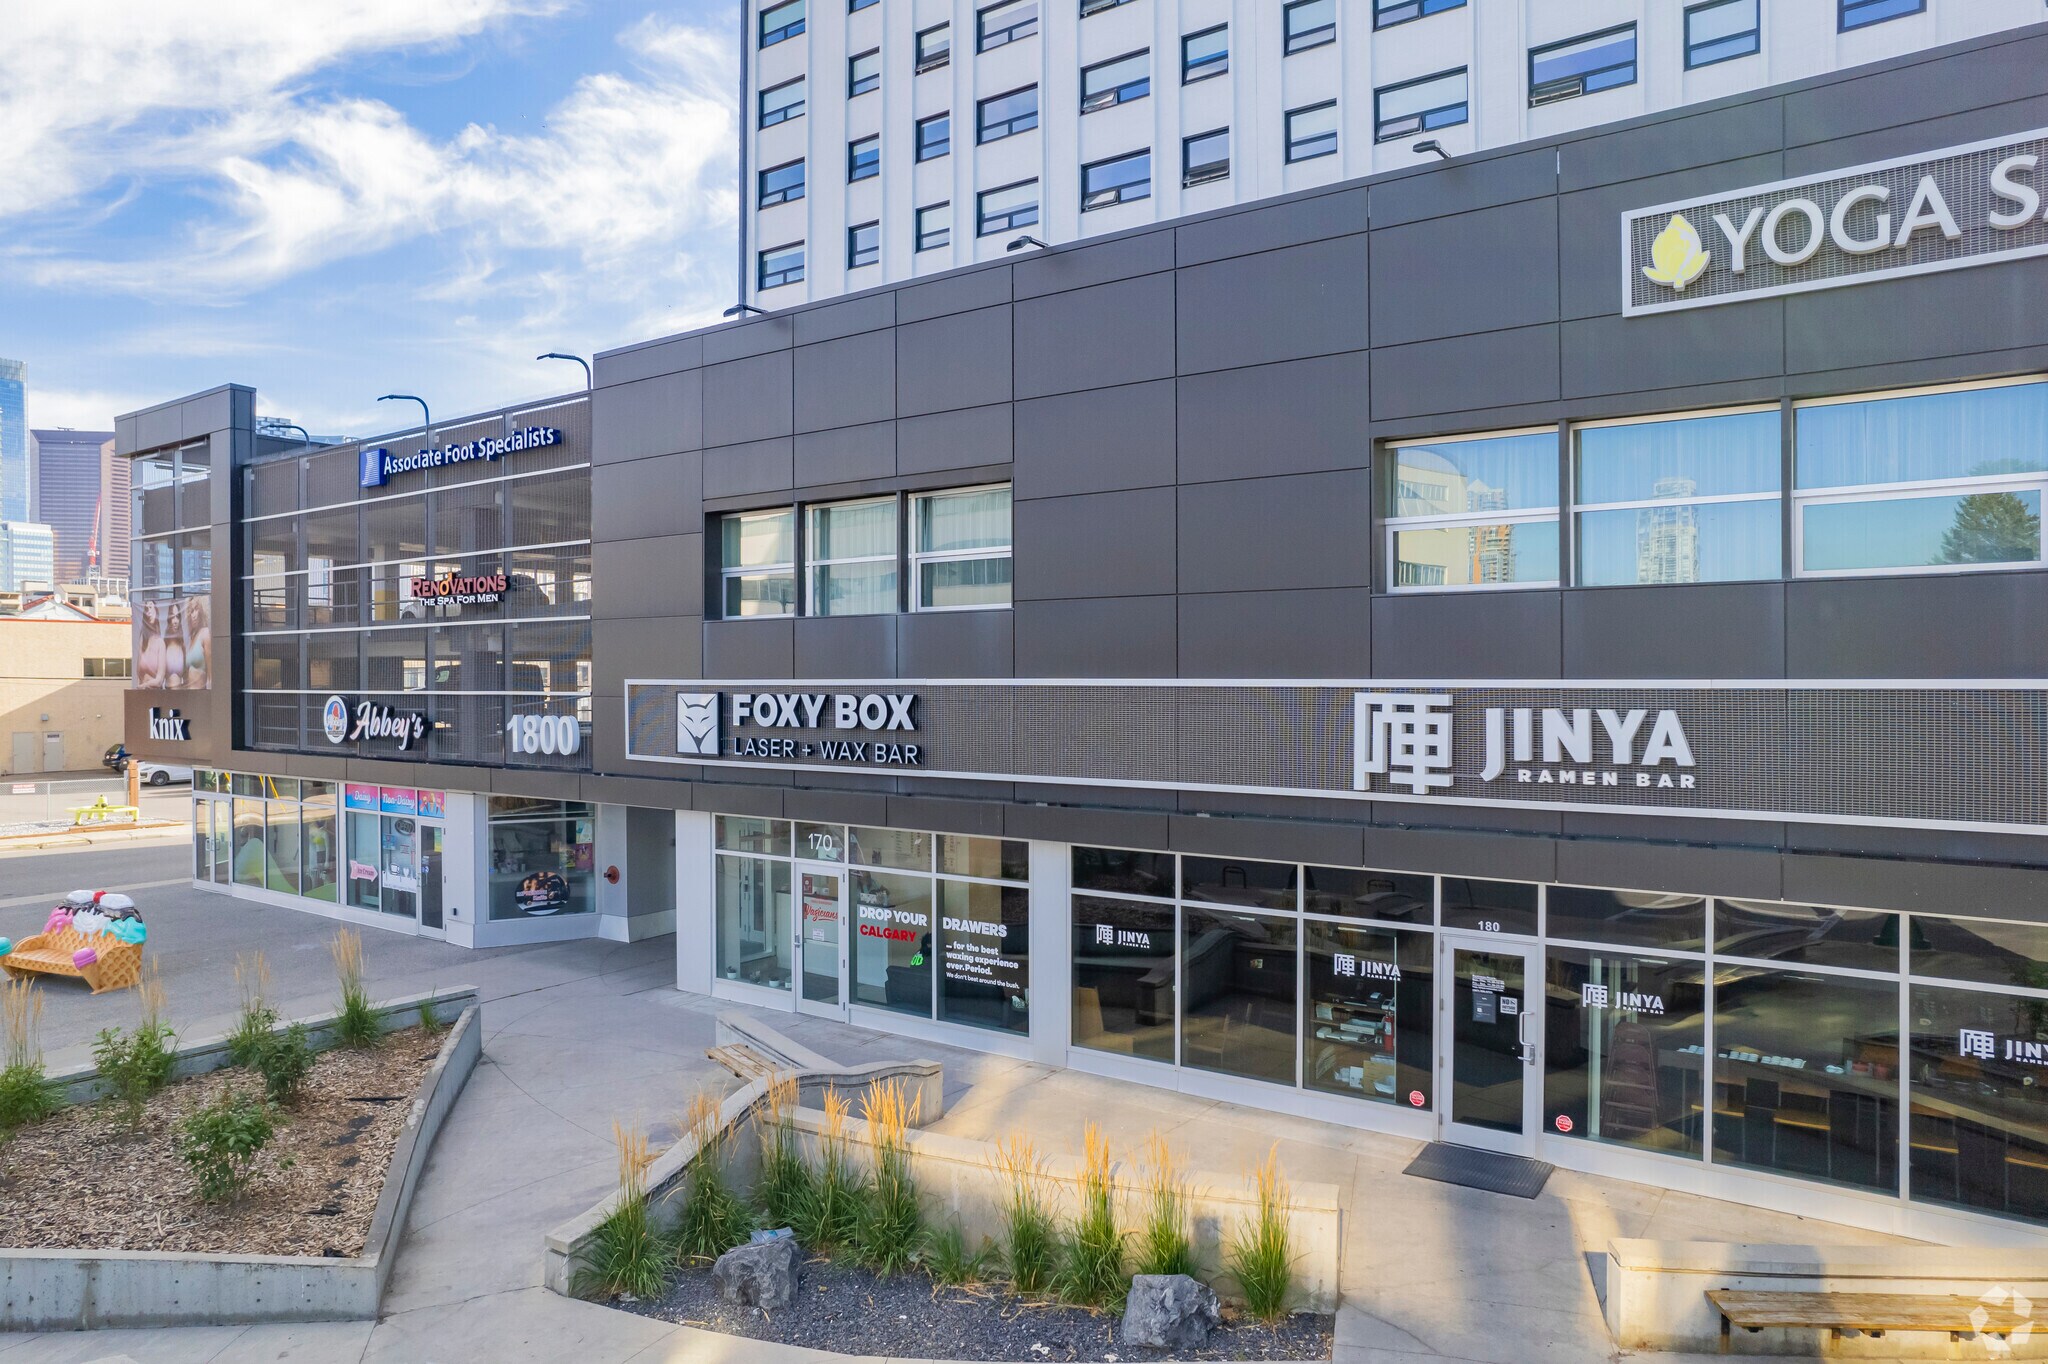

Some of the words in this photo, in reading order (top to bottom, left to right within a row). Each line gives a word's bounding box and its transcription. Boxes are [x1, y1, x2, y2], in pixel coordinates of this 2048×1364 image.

[1713, 175, 1961, 274] YOGA
[1989, 154, 2048, 230] S
[384, 449, 441, 474] Associate
[445, 442, 475, 464] Foot
[478, 427, 554, 461] Specialists
[411, 572, 507, 598] RENOVATIONS
[419, 598, 435, 606] THE
[437, 596, 455, 605] SPA
[457, 595, 475, 604] FOR
[477, 593, 499, 603] MEN
[733, 693, 826, 728] FOXY
[835, 693, 917, 731] BOX
[149, 707, 185, 741] knix
[349, 701, 424, 751] Abbey's
[507, 714, 577, 756] 1800
[1480, 708, 1697, 782] JINYA
[734, 737, 795, 758] LASER
[820, 740, 867, 762] WAX
[875, 743, 919, 765] BAR
[1518, 769, 1618, 786] RAMEN
[1636, 772, 1697, 789] BAR
[808, 833, 833, 852] 170
[859, 907, 893, 921] DROP
[893, 911, 928, 927] YOUR
[1478, 920, 1500, 932] 180
[859, 924, 917, 942] CALGARY
[942, 917, 1007, 938] DRAWERS
[1117, 930, 1150, 945] JINYA
[953, 941, 965, 951] for
[966, 943, 979, 952] the
[981, 945, 999, 955] best
[946, 952, 974, 963] waxing
[975, 957, 1019, 969] experience
[965, 964, 993, 976] Period.
[1361, 960, 1401, 977] JINYA
[1615, 991, 1665, 1010] JINYA
